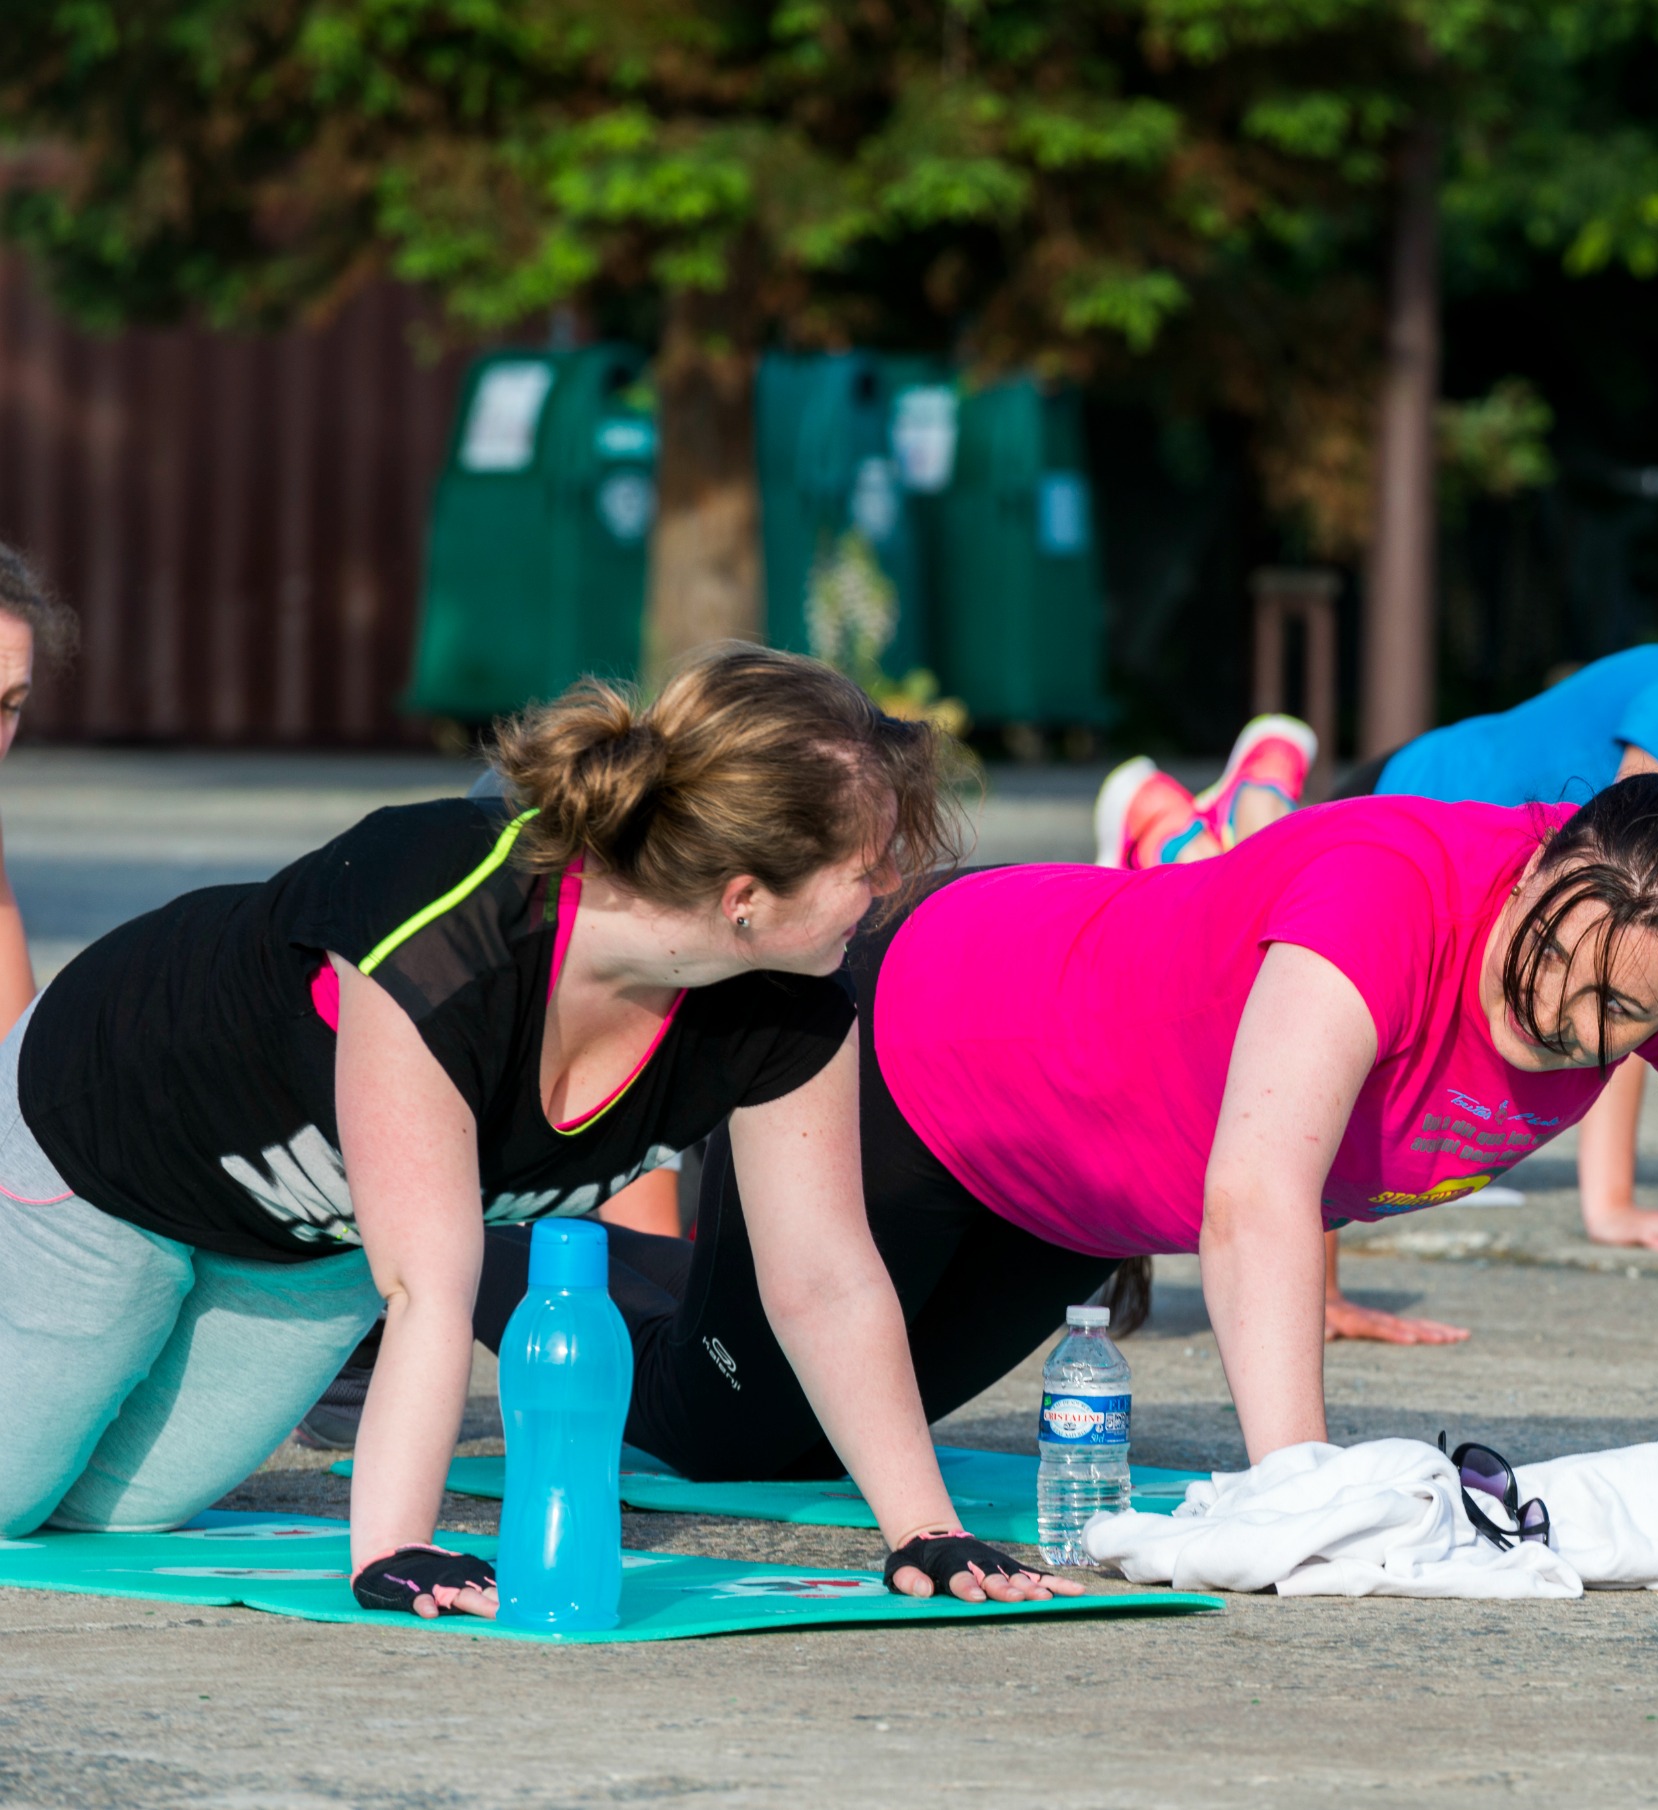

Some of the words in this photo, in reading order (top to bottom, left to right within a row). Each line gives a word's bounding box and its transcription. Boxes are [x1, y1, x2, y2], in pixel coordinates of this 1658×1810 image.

[1451, 1119, 1477, 1139] dit
[1477, 1132, 1506, 1145] que
[1044, 1411, 1102, 1423] CRISTALINE
